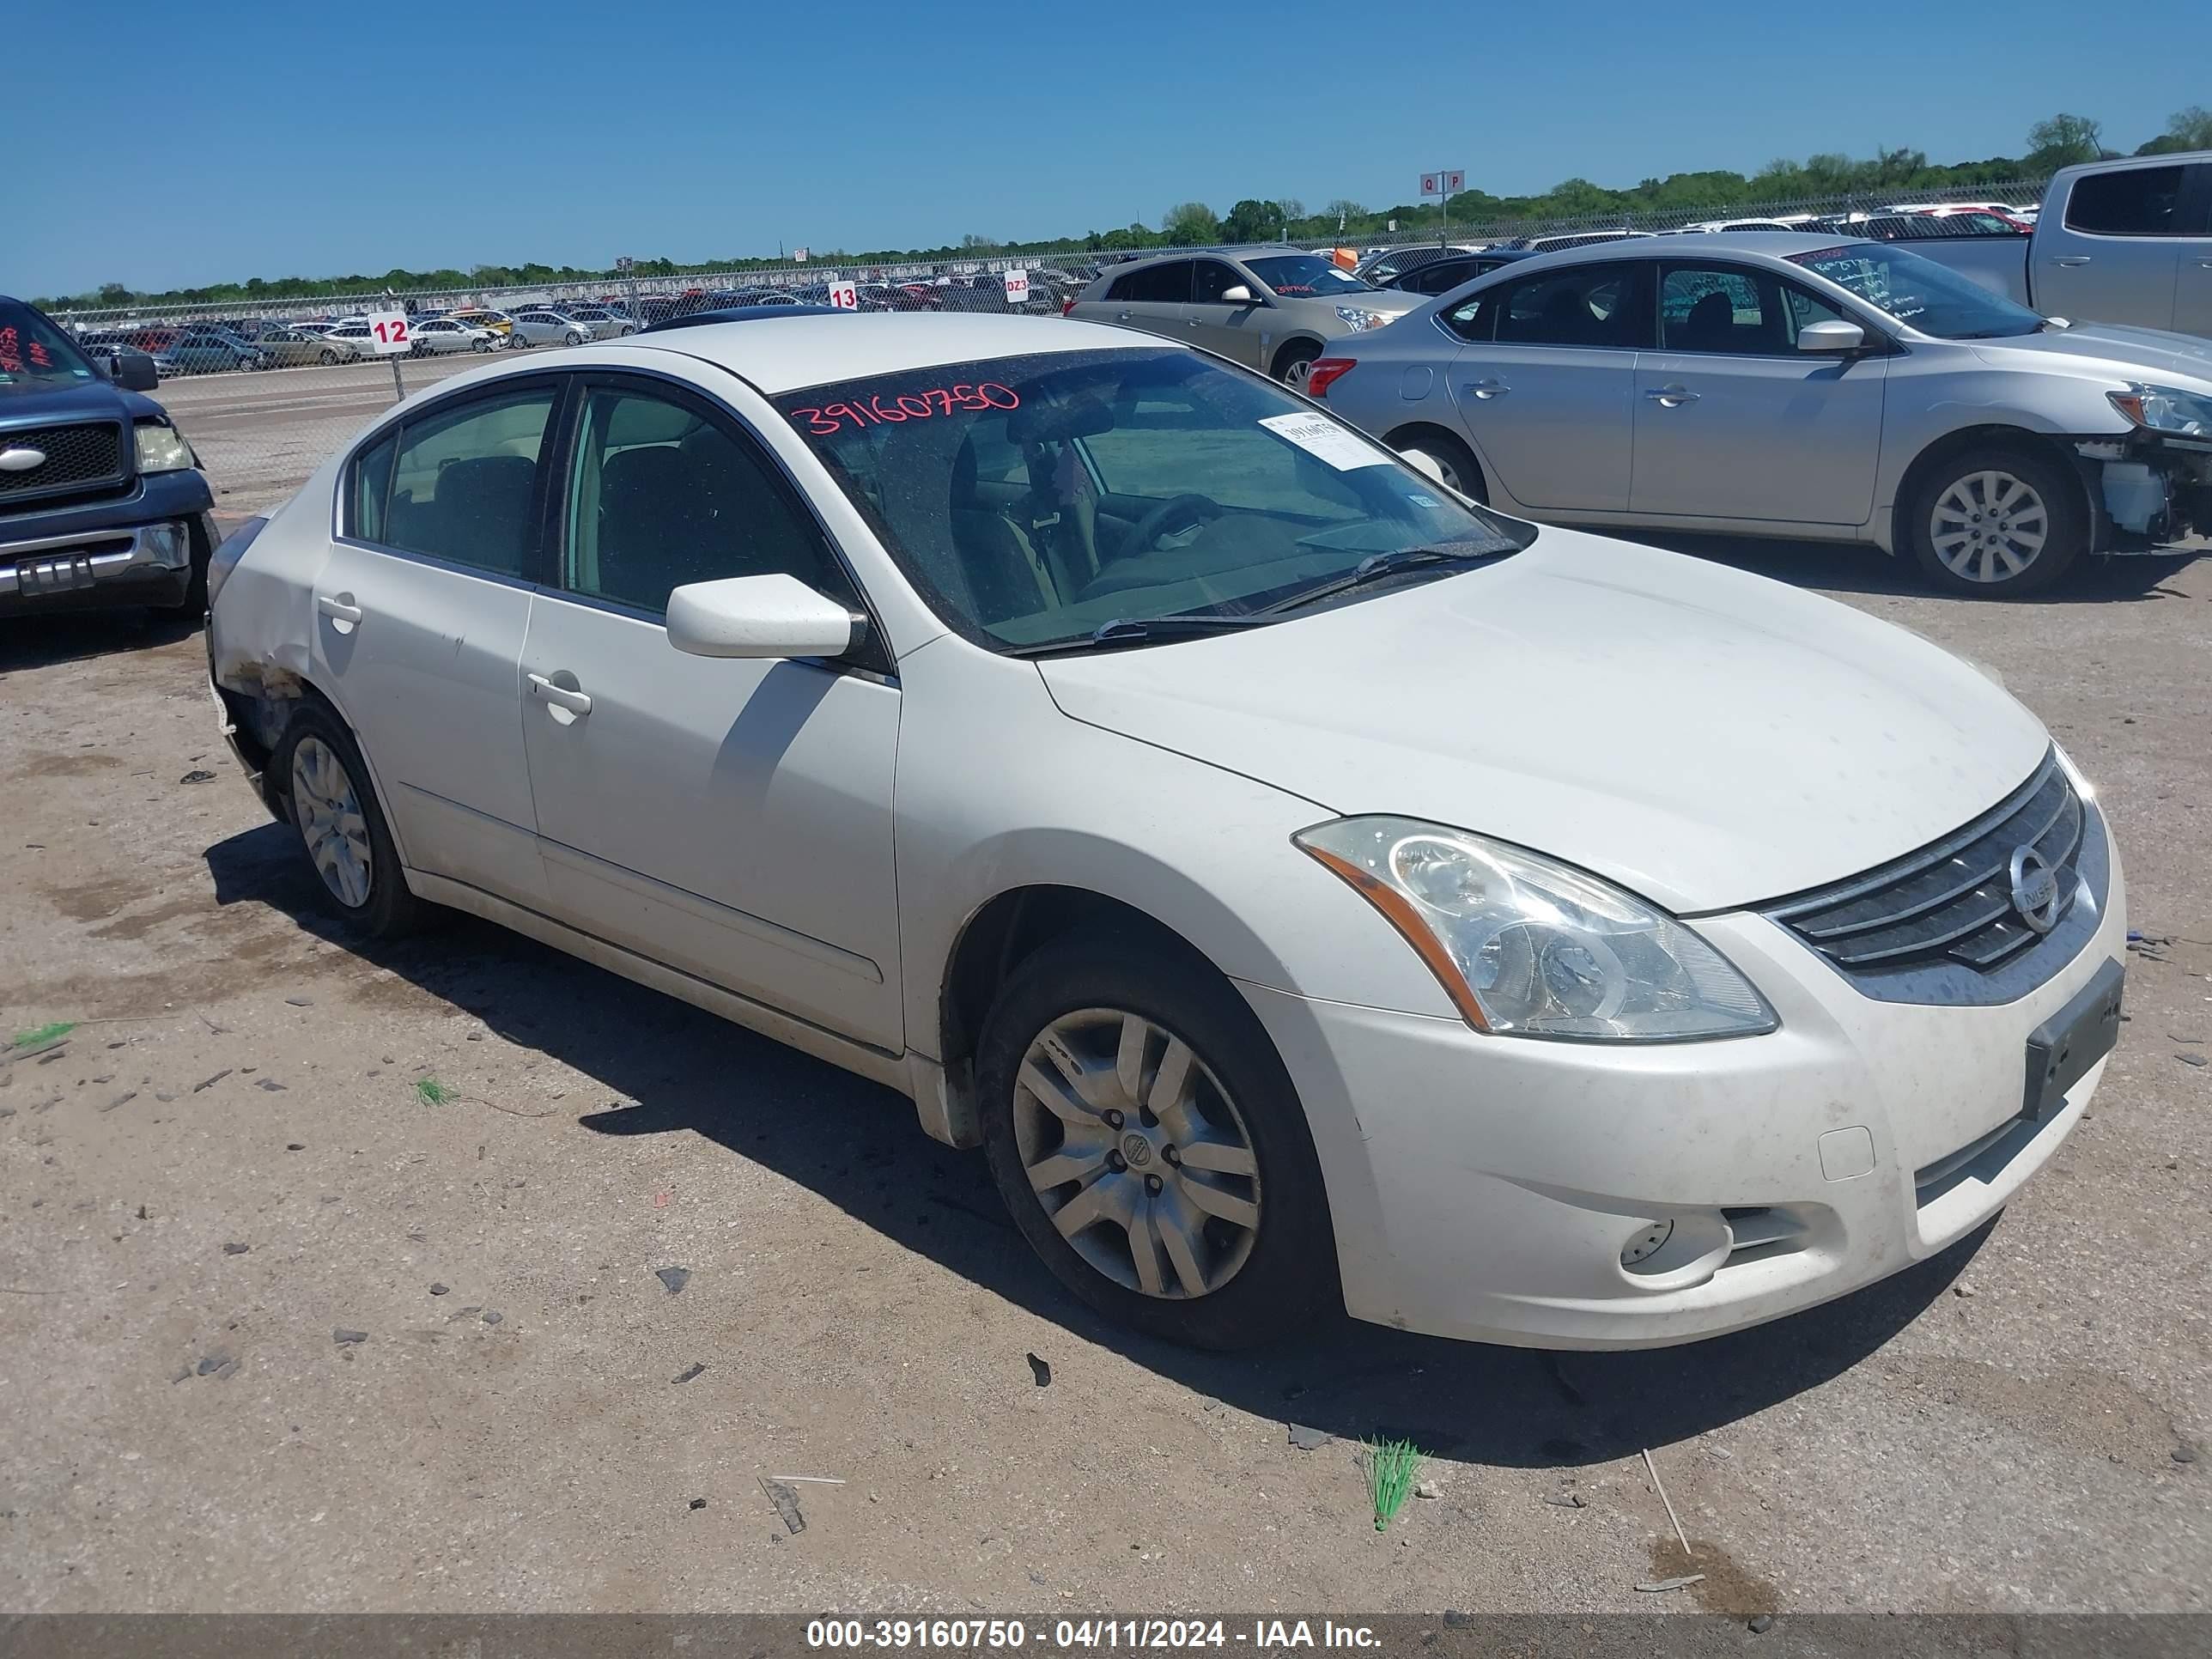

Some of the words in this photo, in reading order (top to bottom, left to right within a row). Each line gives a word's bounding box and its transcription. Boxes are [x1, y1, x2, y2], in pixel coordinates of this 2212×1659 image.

[1425, 179, 1432, 191] Q
[1452, 176, 1458, 188] P
[1006, 280, 1027, 292] DZ3
[833, 289, 855, 308] 13
[374, 320, 408, 343] 12
[790, 383, 1020, 434] 39160750
